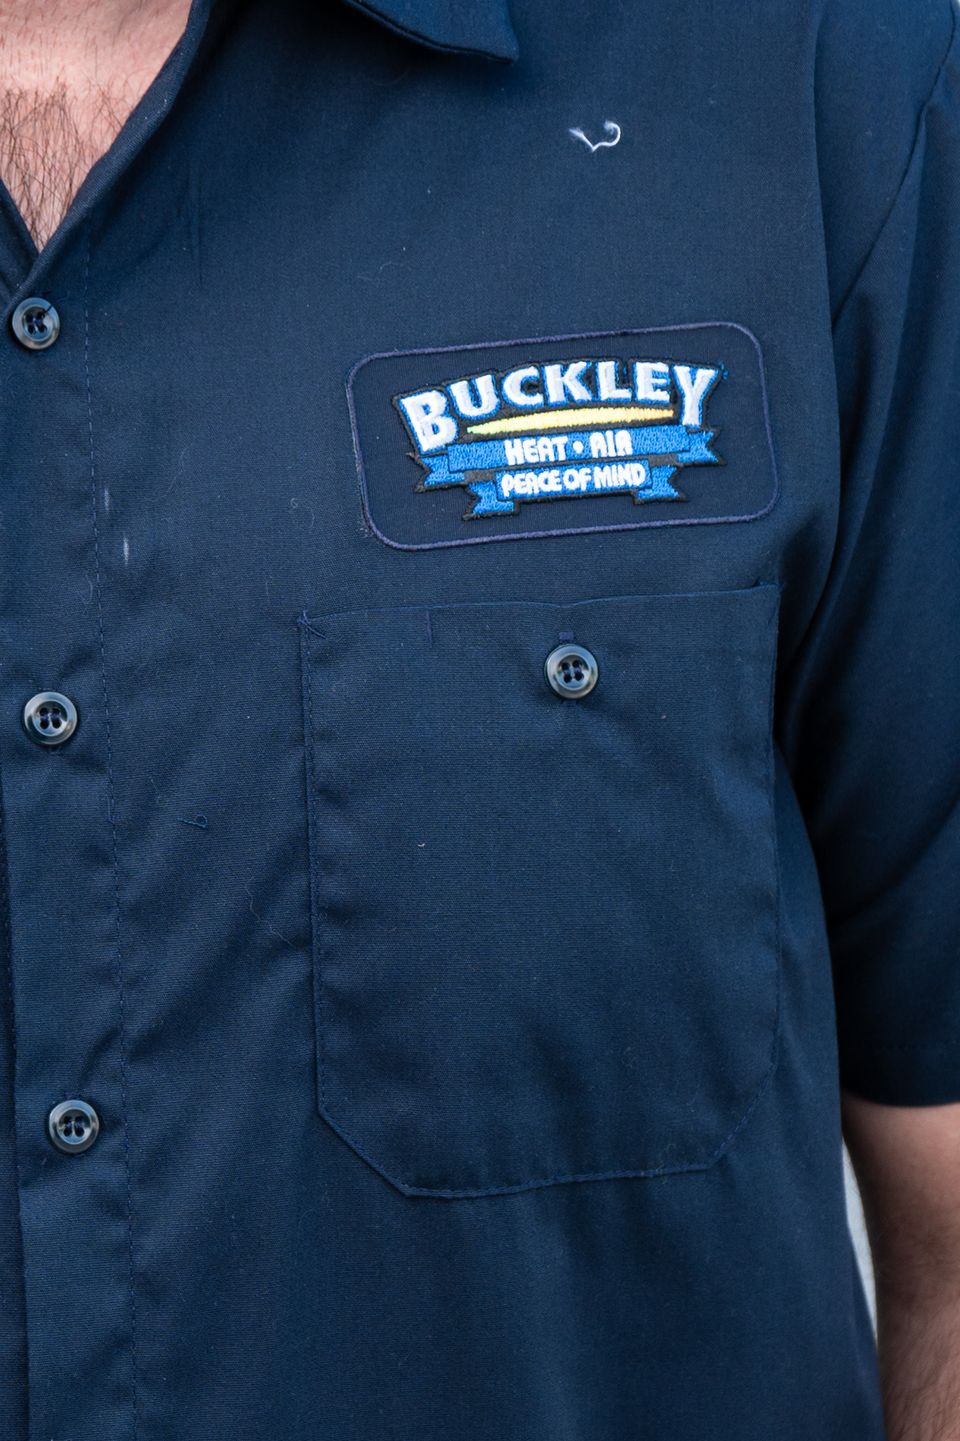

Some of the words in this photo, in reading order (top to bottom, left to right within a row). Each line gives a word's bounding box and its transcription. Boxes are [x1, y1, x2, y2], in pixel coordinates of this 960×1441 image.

[400, 360, 720, 453] BUCKLEY
[503, 436, 568, 466] HEAT
[591, 430, 634, 457] AIR
[500, 470, 563, 497] PEACE
[563, 467, 592, 490] OF
[593, 462, 647, 489] MIND
